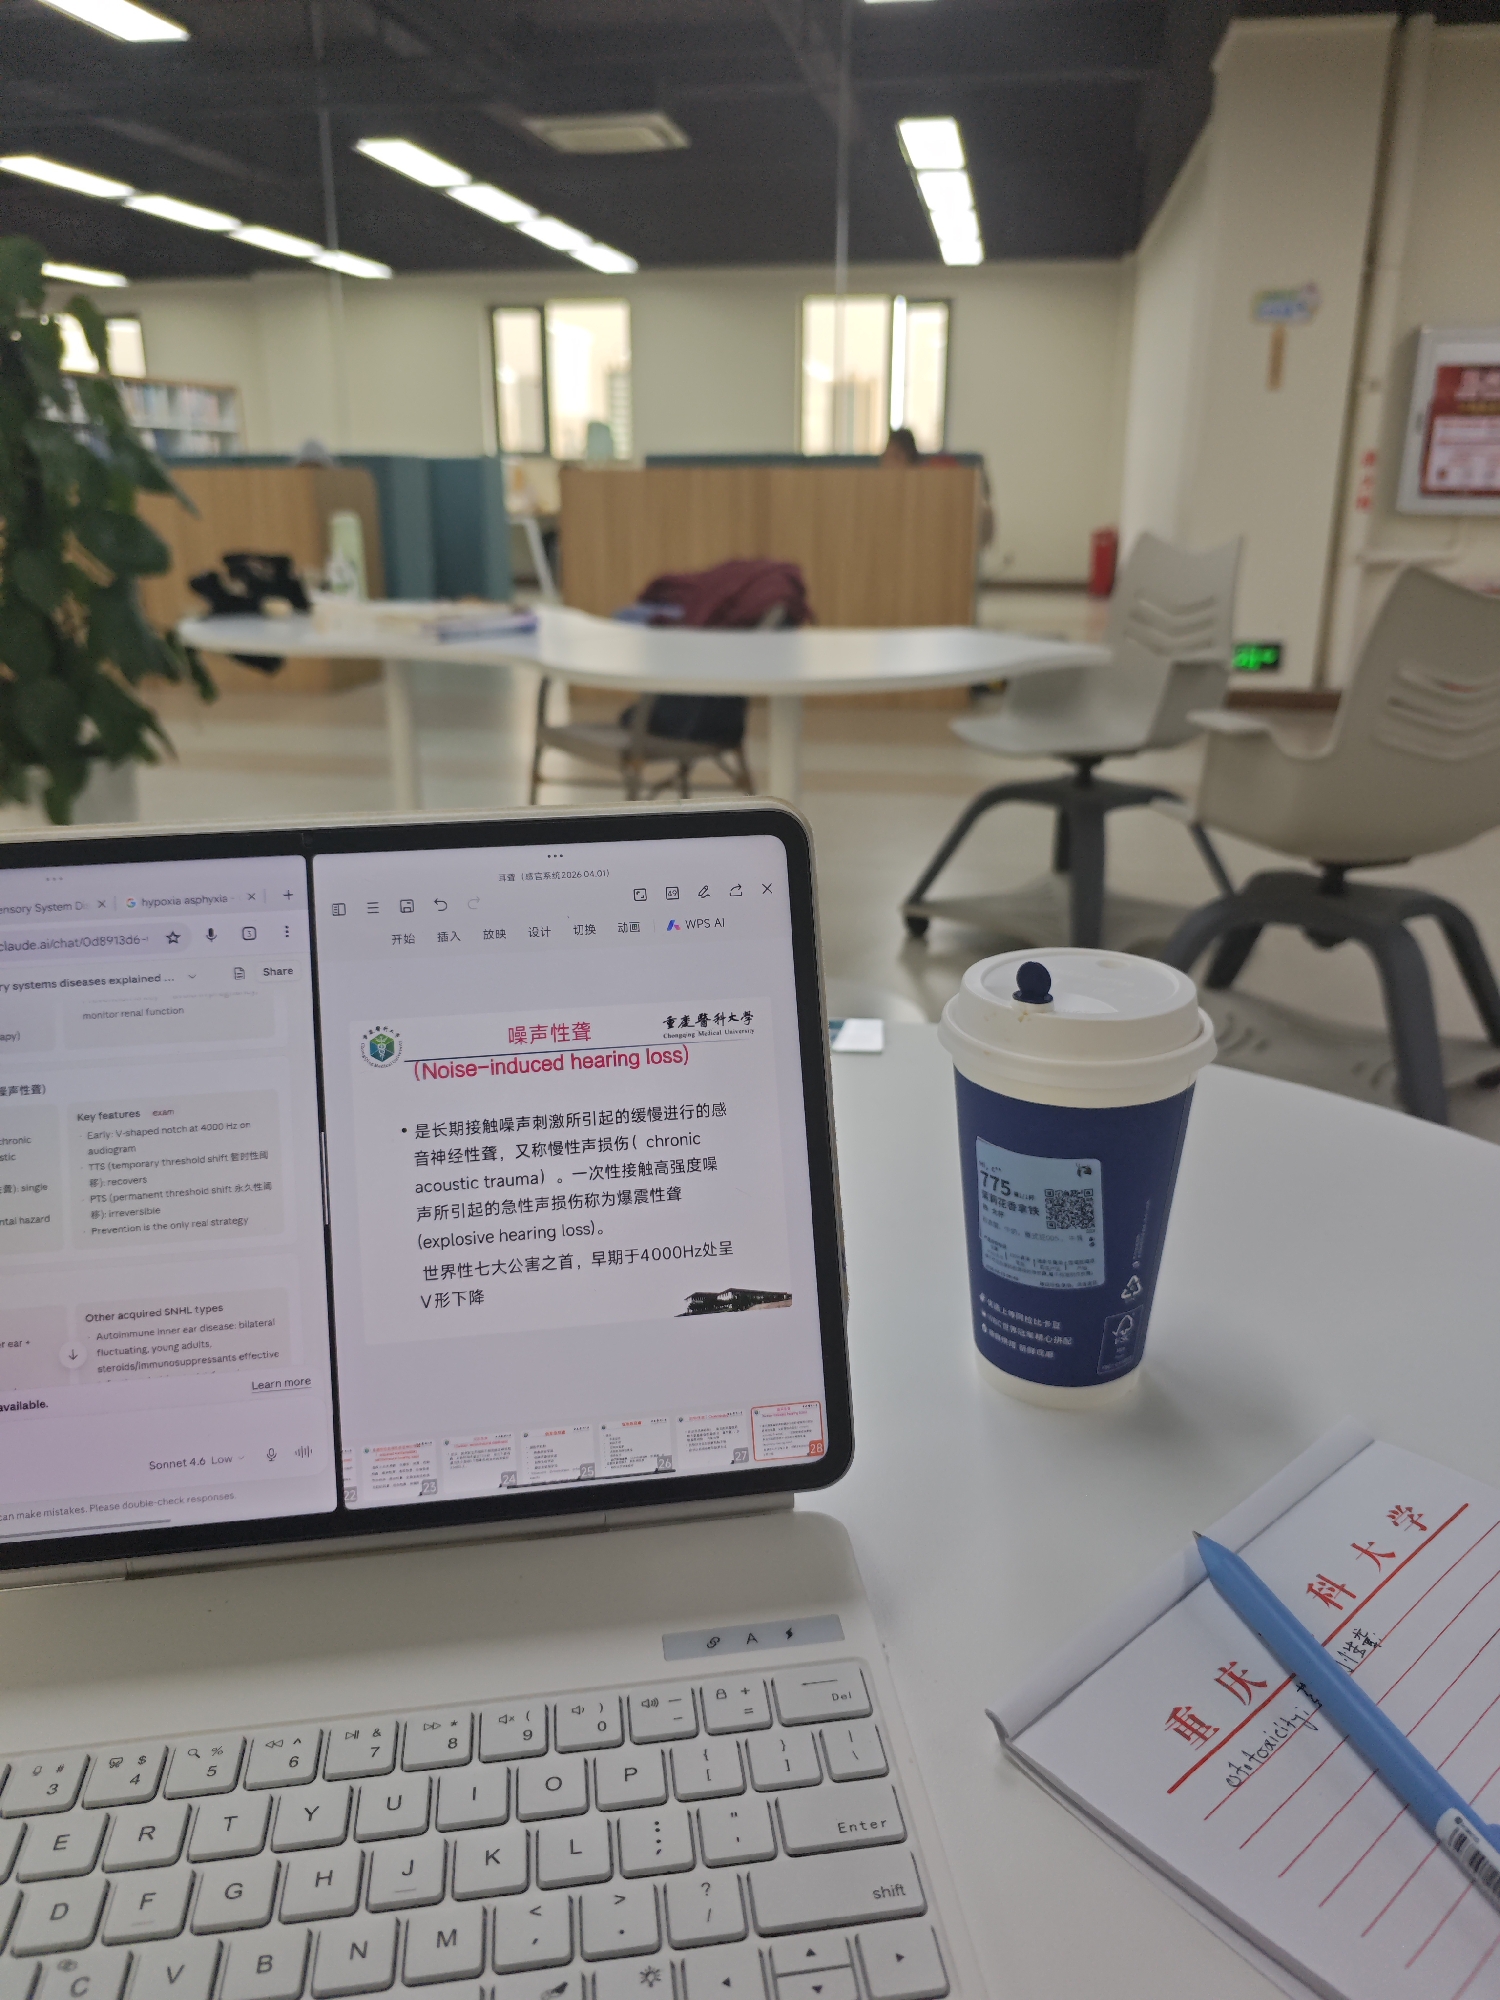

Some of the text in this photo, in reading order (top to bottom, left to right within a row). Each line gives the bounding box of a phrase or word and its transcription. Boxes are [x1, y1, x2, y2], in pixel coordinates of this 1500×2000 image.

[35, 902, 72, 915] System
[141, 893, 228, 909] hypoxia asphyxia
[528, 925, 552, 938] 设计
[573, 923, 597, 936] 切换
[617, 921, 641, 934] 动画
[684, 917, 725, 930] WPS AI
[391, 933, 416, 946] 开始
[436, 930, 462, 943] 插入
[482, 928, 507, 940] 放映
[263, 966, 294, 977] Share
[12, 980, 58, 993] systems
[60, 977, 107, 989] diseases
[109, 974, 162, 986] explained
[82, 1006, 185, 1020] monitor renal function
[507, 1020, 592, 1046] 噪声性聋
[698, 1028, 722, 1037] Medical
[413, 1052, 564, 1082] (Noise-induced
[570, 1047, 641, 1070] hearing
[645, 1043, 690, 1066] loss)
[76, 1108, 175, 1123] Key features exam
[414, 1101, 728, 1140] 是长期接触噪声刺激所引起的缓慢进行的感
[87, 1130, 114, 1141] Early:
[115, 1126, 160, 1138] V-shaped
[161, 1124, 188, 1135] notch
[189, 1124, 199, 1133] at
[226, 1121, 238, 1130] Hz
[239, 1121, 251, 1130] on
[646, 1131, 701, 1149] chronic
[87, 1144, 137, 1156] audiogram
[88, 1162, 106, 1172] TTS
[107, 1158, 160, 1172] (temporary
[161, 1155, 206, 1168] threshold
[207, 1153, 229, 1164] shift
[20, 1182, 48, 1194] single
[107, 1175, 148, 1187] recovers
[415, 1175, 479, 1194] acoustic
[980, 1169, 1011, 1197] 775
[90, 1193, 108, 1204] PTS
[109, 1189, 163, 1204] (permanent
[165, 1186, 209, 1199] threshold
[211, 1184, 233, 1195] shift
[108, 1205, 161, 1218] irreversible
[416, 1186, 682, 1223] 声所引起的急性声损伤称为爆震性聋
[18, 1213, 51, 1225] hazard
[91, 1215, 250, 1236] Prevention is the only real strategy
[417, 1227, 495, 1250] (explosive
[498, 1223, 557, 1244] hearing
[85, 1303, 224, 1323] Other acquired SNHL types
[96, 1317, 276, 1341] Autoimmune inner ear disease: bilateral
[7, 1340, 23, 1348] ear
[151, 1342, 180, 1354] young
[96, 1350, 280, 1374] steroids/immunosuppressants effective
[251, 1377, 312, 1391] Learn more
[0, 1400, 49, 1413] available.
[734, 1450, 748, 1462] 27
[810, 1442, 823, 1455] 28
[149, 1455, 233, 1470] Sonnet 4.6 Low
[658, 1458, 671, 1470] 26
[502, 1474, 516, 1486] 24
[581, 1467, 594, 1479] 25
[423, 1482, 437, 1494] 23
[16, 1508, 42, 1520] make
[43, 1505, 88, 1518] mistakes.
[89, 1501, 121, 1513] Please
[122, 1495, 185, 1511] double-check
[831, 1690, 852, 1703] Del
[448, 1737, 459, 1749] 8
[523, 1728, 534, 1742] 9
[370, 1747, 380, 1758] 7
[288, 1756, 299, 1768] 6
[207, 1765, 217, 1777] 5
[625, 1766, 638, 1783] P
[130, 1774, 141, 1786] 4
[46, 1783, 58, 1796] 3
[386, 1796, 402, 1812] U
[304, 1806, 320, 1823] Y
[224, 1815, 238, 1832] T
[837, 1817, 888, 1835] Enter
[138, 1825, 156, 1842] R
[53, 1834, 70, 1851] E
[569, 1839, 583, 1856] L
[485, 1849, 501, 1867] K
[402, 1859, 415, 1878] J
[315, 1870, 333, 1888] H
[224, 1882, 243, 1900] G
[873, 1883, 907, 1900] shift
[139, 1892, 156, 1910] F
[51, 1903, 69, 1921] D
[435, 1930, 458, 1949] M
[349, 1941, 368, 1960] N
[256, 1955, 273, 1974] B
[166, 1965, 184, 1984] V
